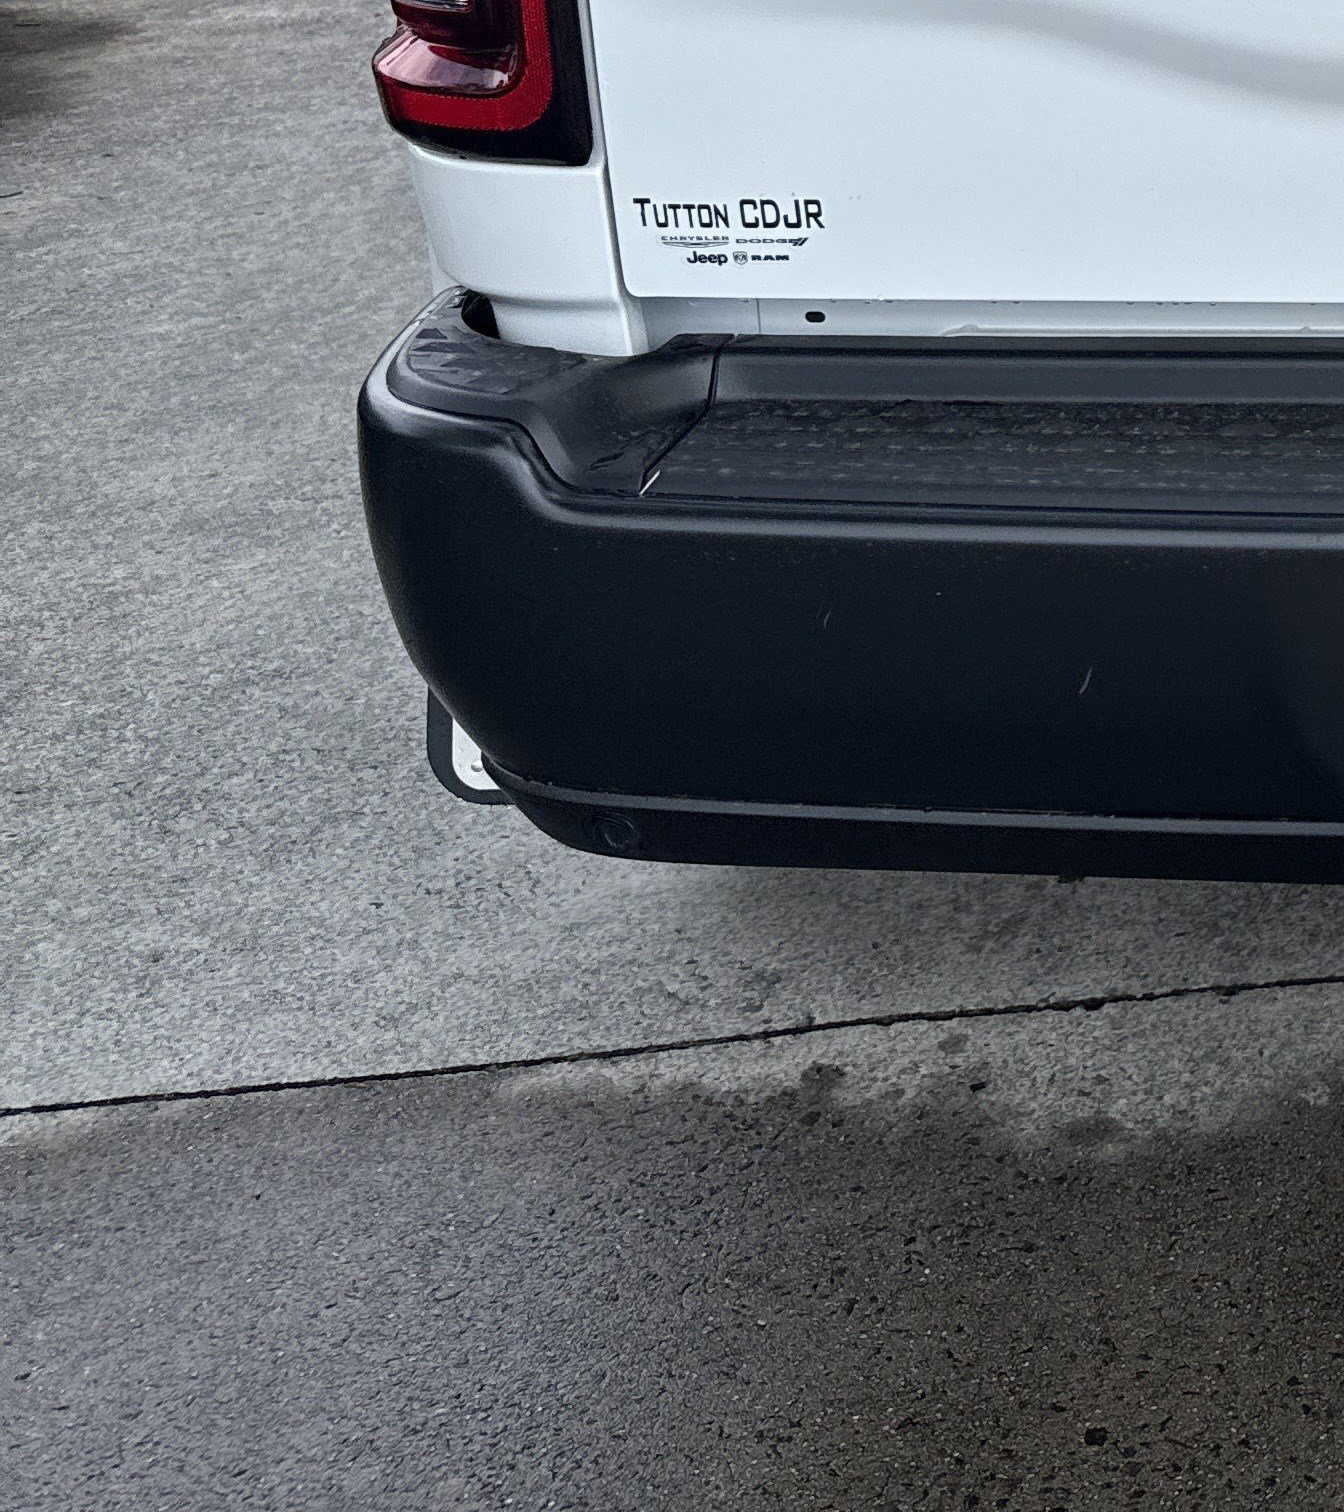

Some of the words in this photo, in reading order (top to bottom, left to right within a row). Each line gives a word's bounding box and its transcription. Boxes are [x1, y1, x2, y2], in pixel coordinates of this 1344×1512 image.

[633, 197, 730, 229] TUTTON
[738, 198, 826, 229] CDJR
[686, 250, 729, 267] Jeep
[751, 254, 790, 262] RAM
